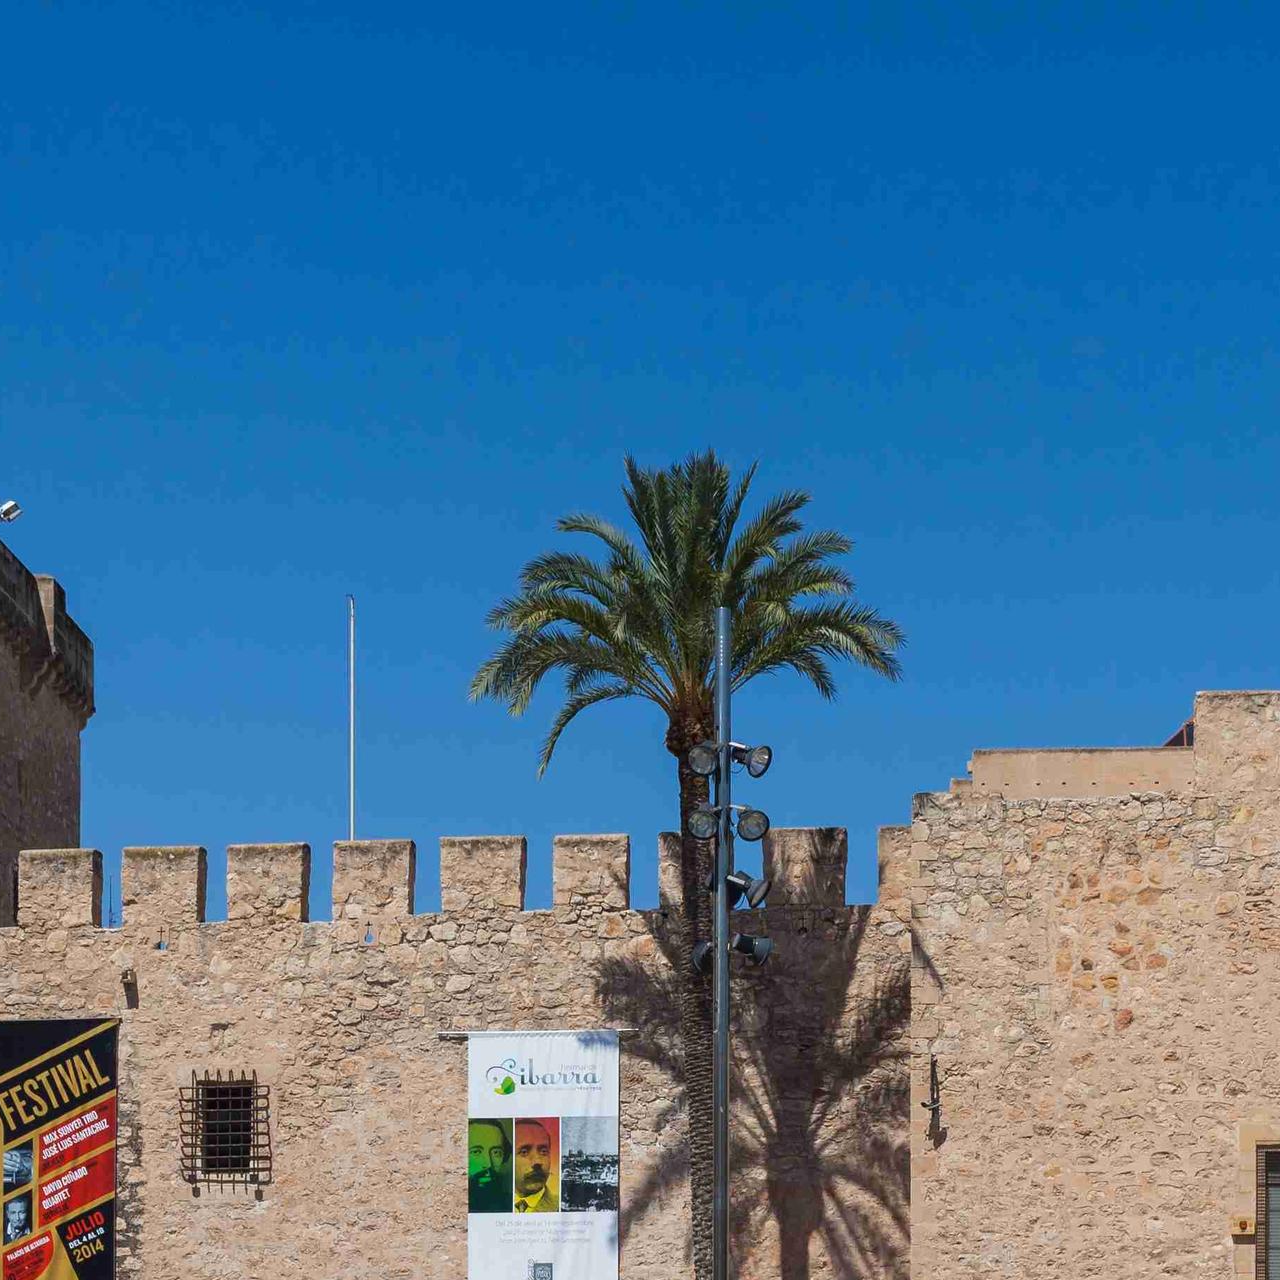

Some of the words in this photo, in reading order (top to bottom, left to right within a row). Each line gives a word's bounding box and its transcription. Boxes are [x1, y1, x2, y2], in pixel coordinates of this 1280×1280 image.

[43, 1131, 60, 1145] MAX
[83, 1110, 98, 1124] TRIO
[58, 1137, 73, 1151] LUIS
[72, 1118, 110, 1144] SANTACRUZ
[42, 1179, 63, 1196] DAVID
[42, 1188, 71, 1210] QUARTET
[65, 1211, 105, 1241] JULIO
[68, 1239, 82, 1249] DEL
[82, 1234, 89, 1243] 4
[88, 1230, 97, 1238] AL
[73, 1237, 105, 1264] 2014
